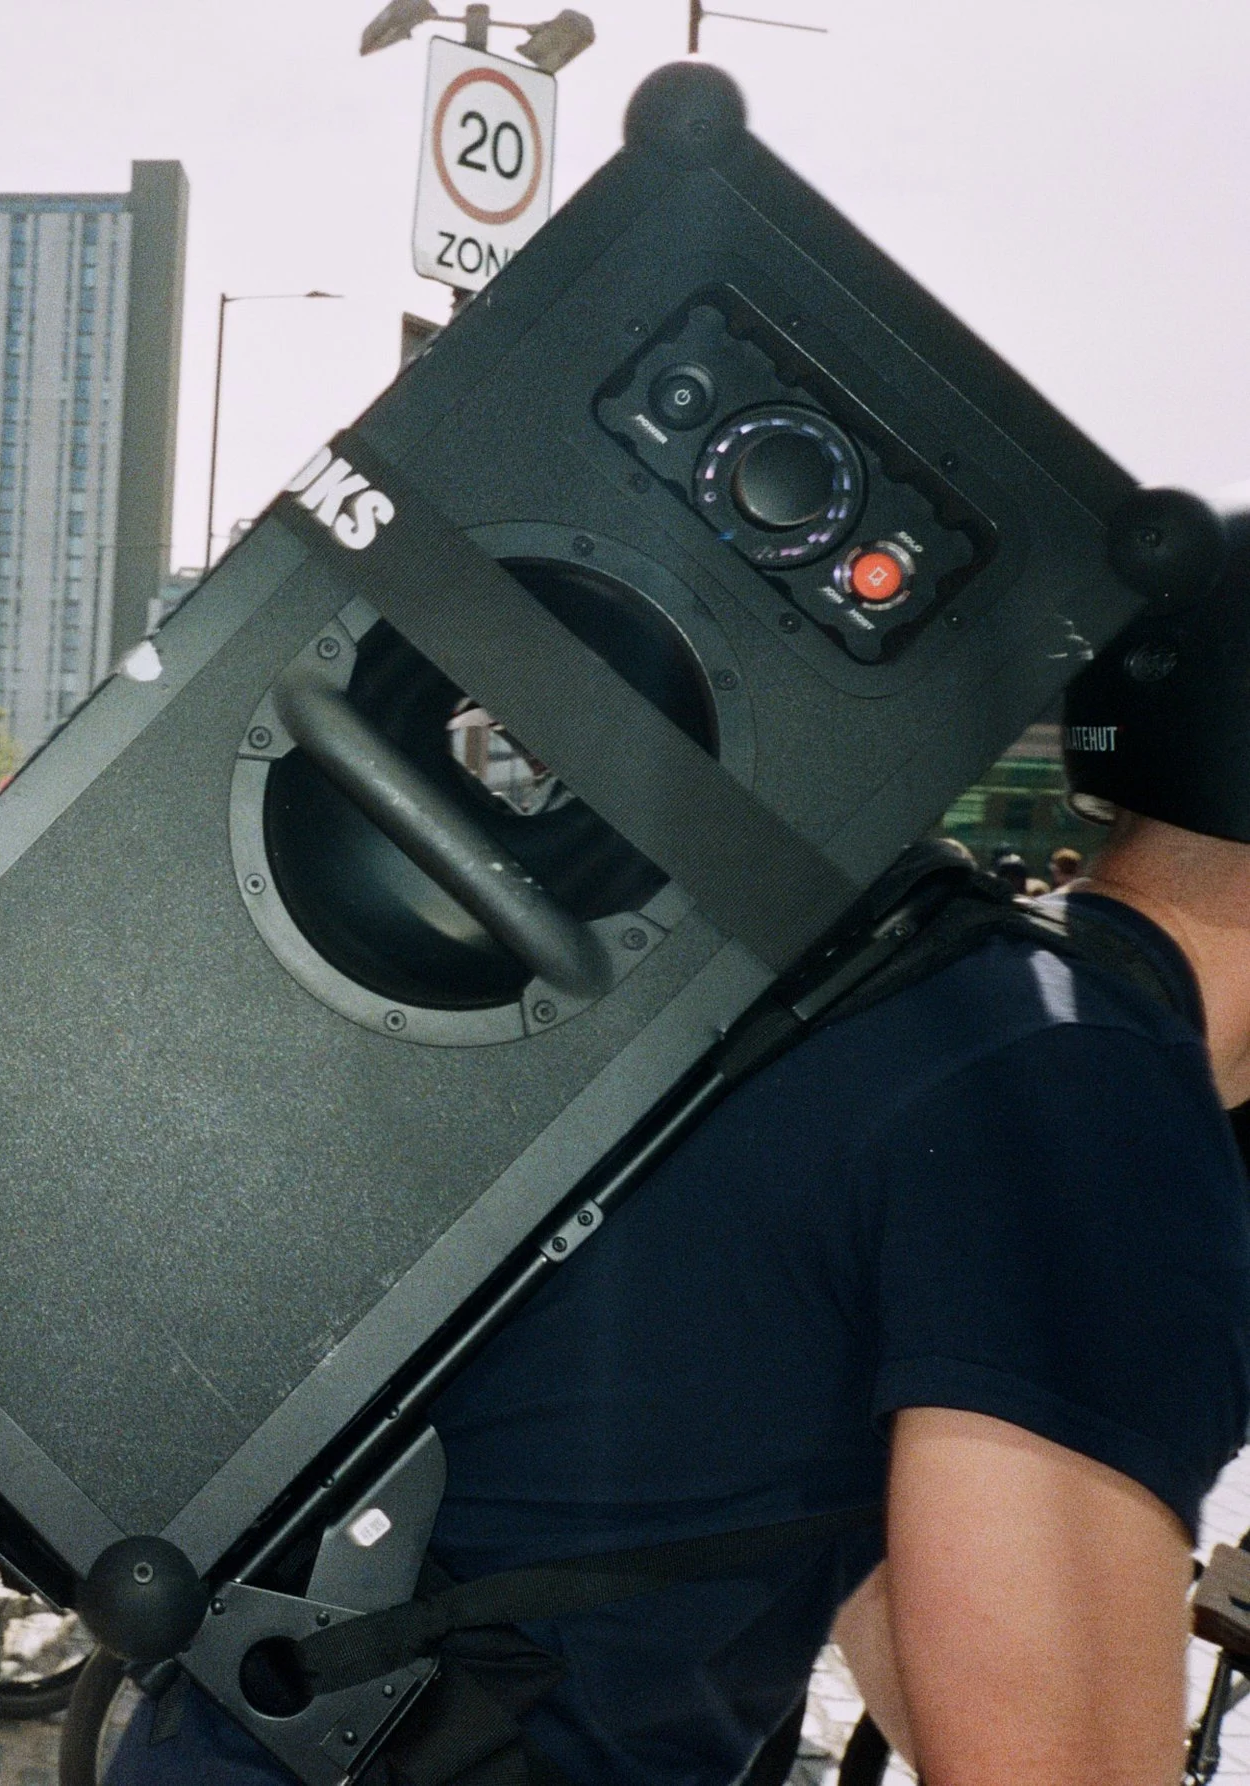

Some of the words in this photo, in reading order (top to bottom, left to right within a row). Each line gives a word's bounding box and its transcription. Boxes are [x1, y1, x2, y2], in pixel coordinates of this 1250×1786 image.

[457, 110, 524, 180] 20
[436, 230, 518, 277] ZON
[897, 531, 924, 553] SOLO
